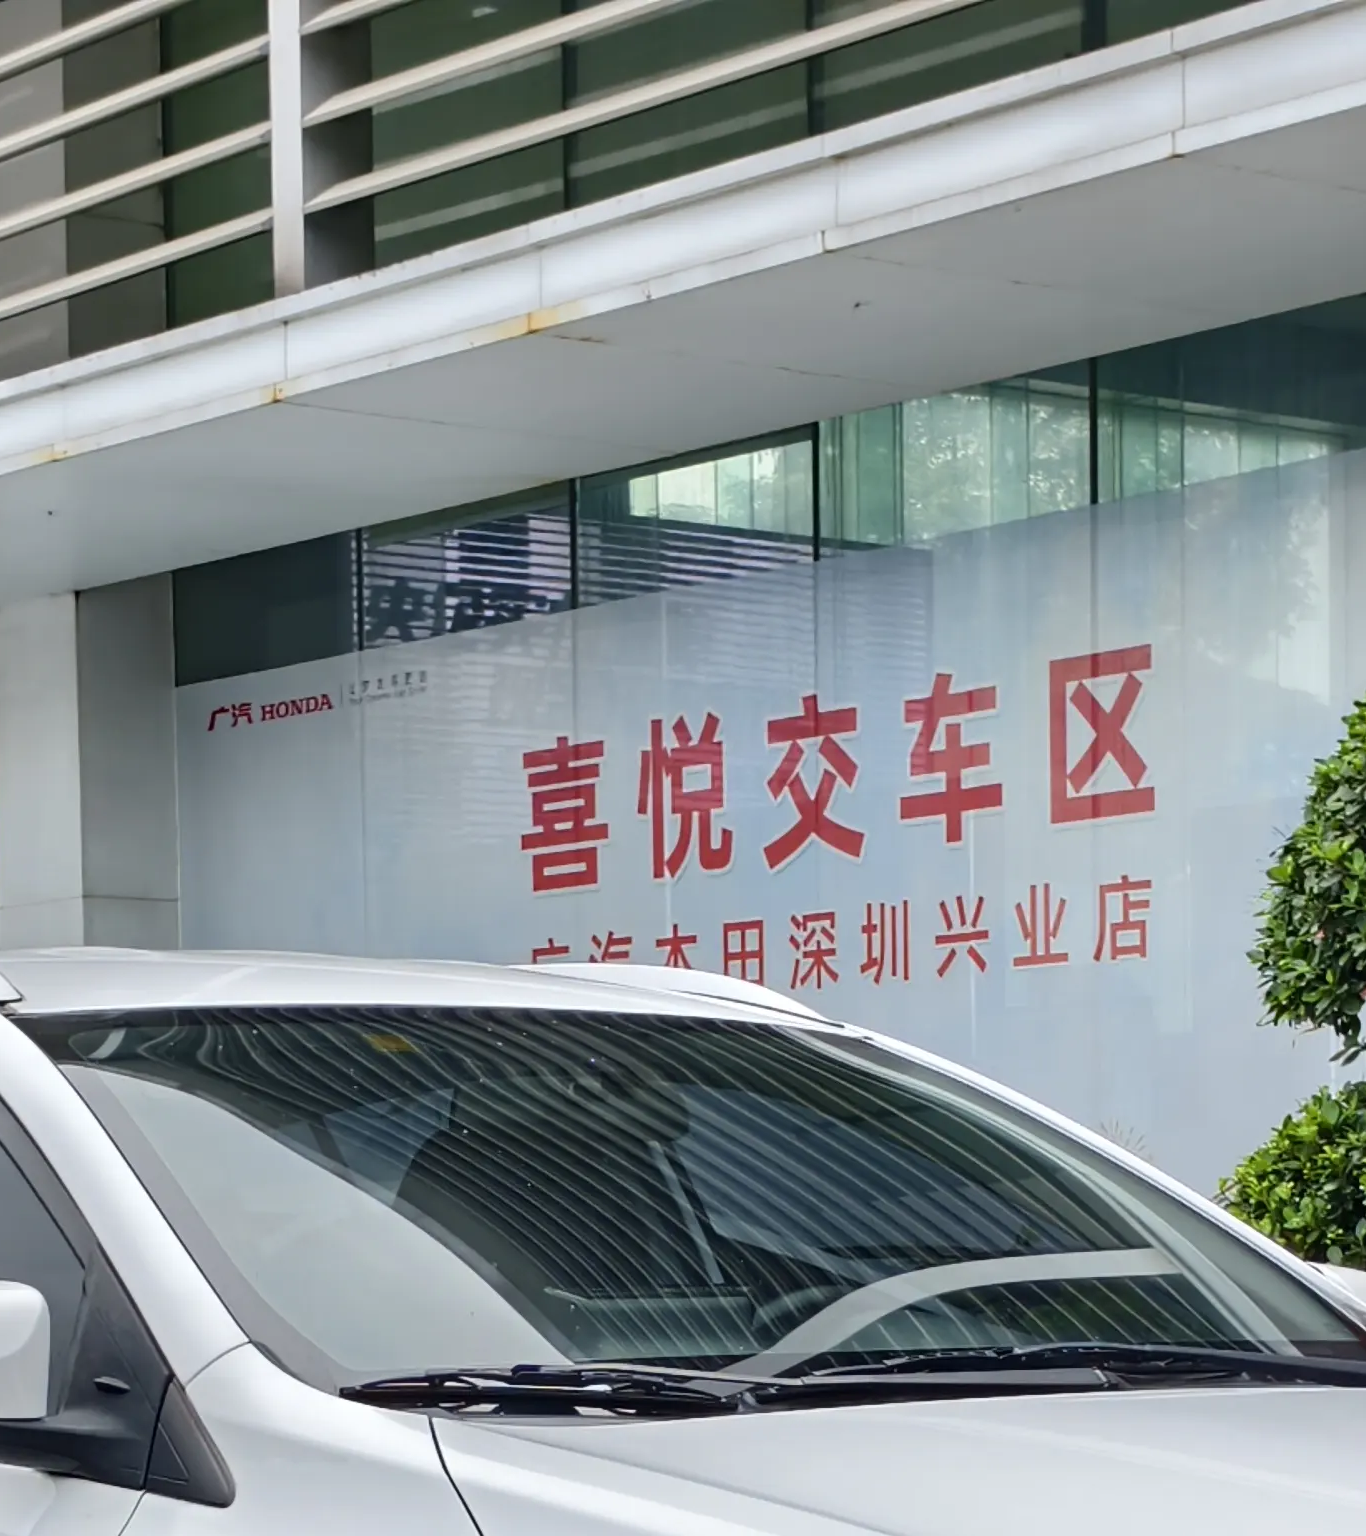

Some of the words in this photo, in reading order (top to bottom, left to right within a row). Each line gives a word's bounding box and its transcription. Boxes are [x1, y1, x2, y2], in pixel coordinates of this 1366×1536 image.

[207, 702, 254, 732] 广汽
[261, 693, 334, 722] HONDA
[521, 644, 1156, 892] 喜悦交车区
